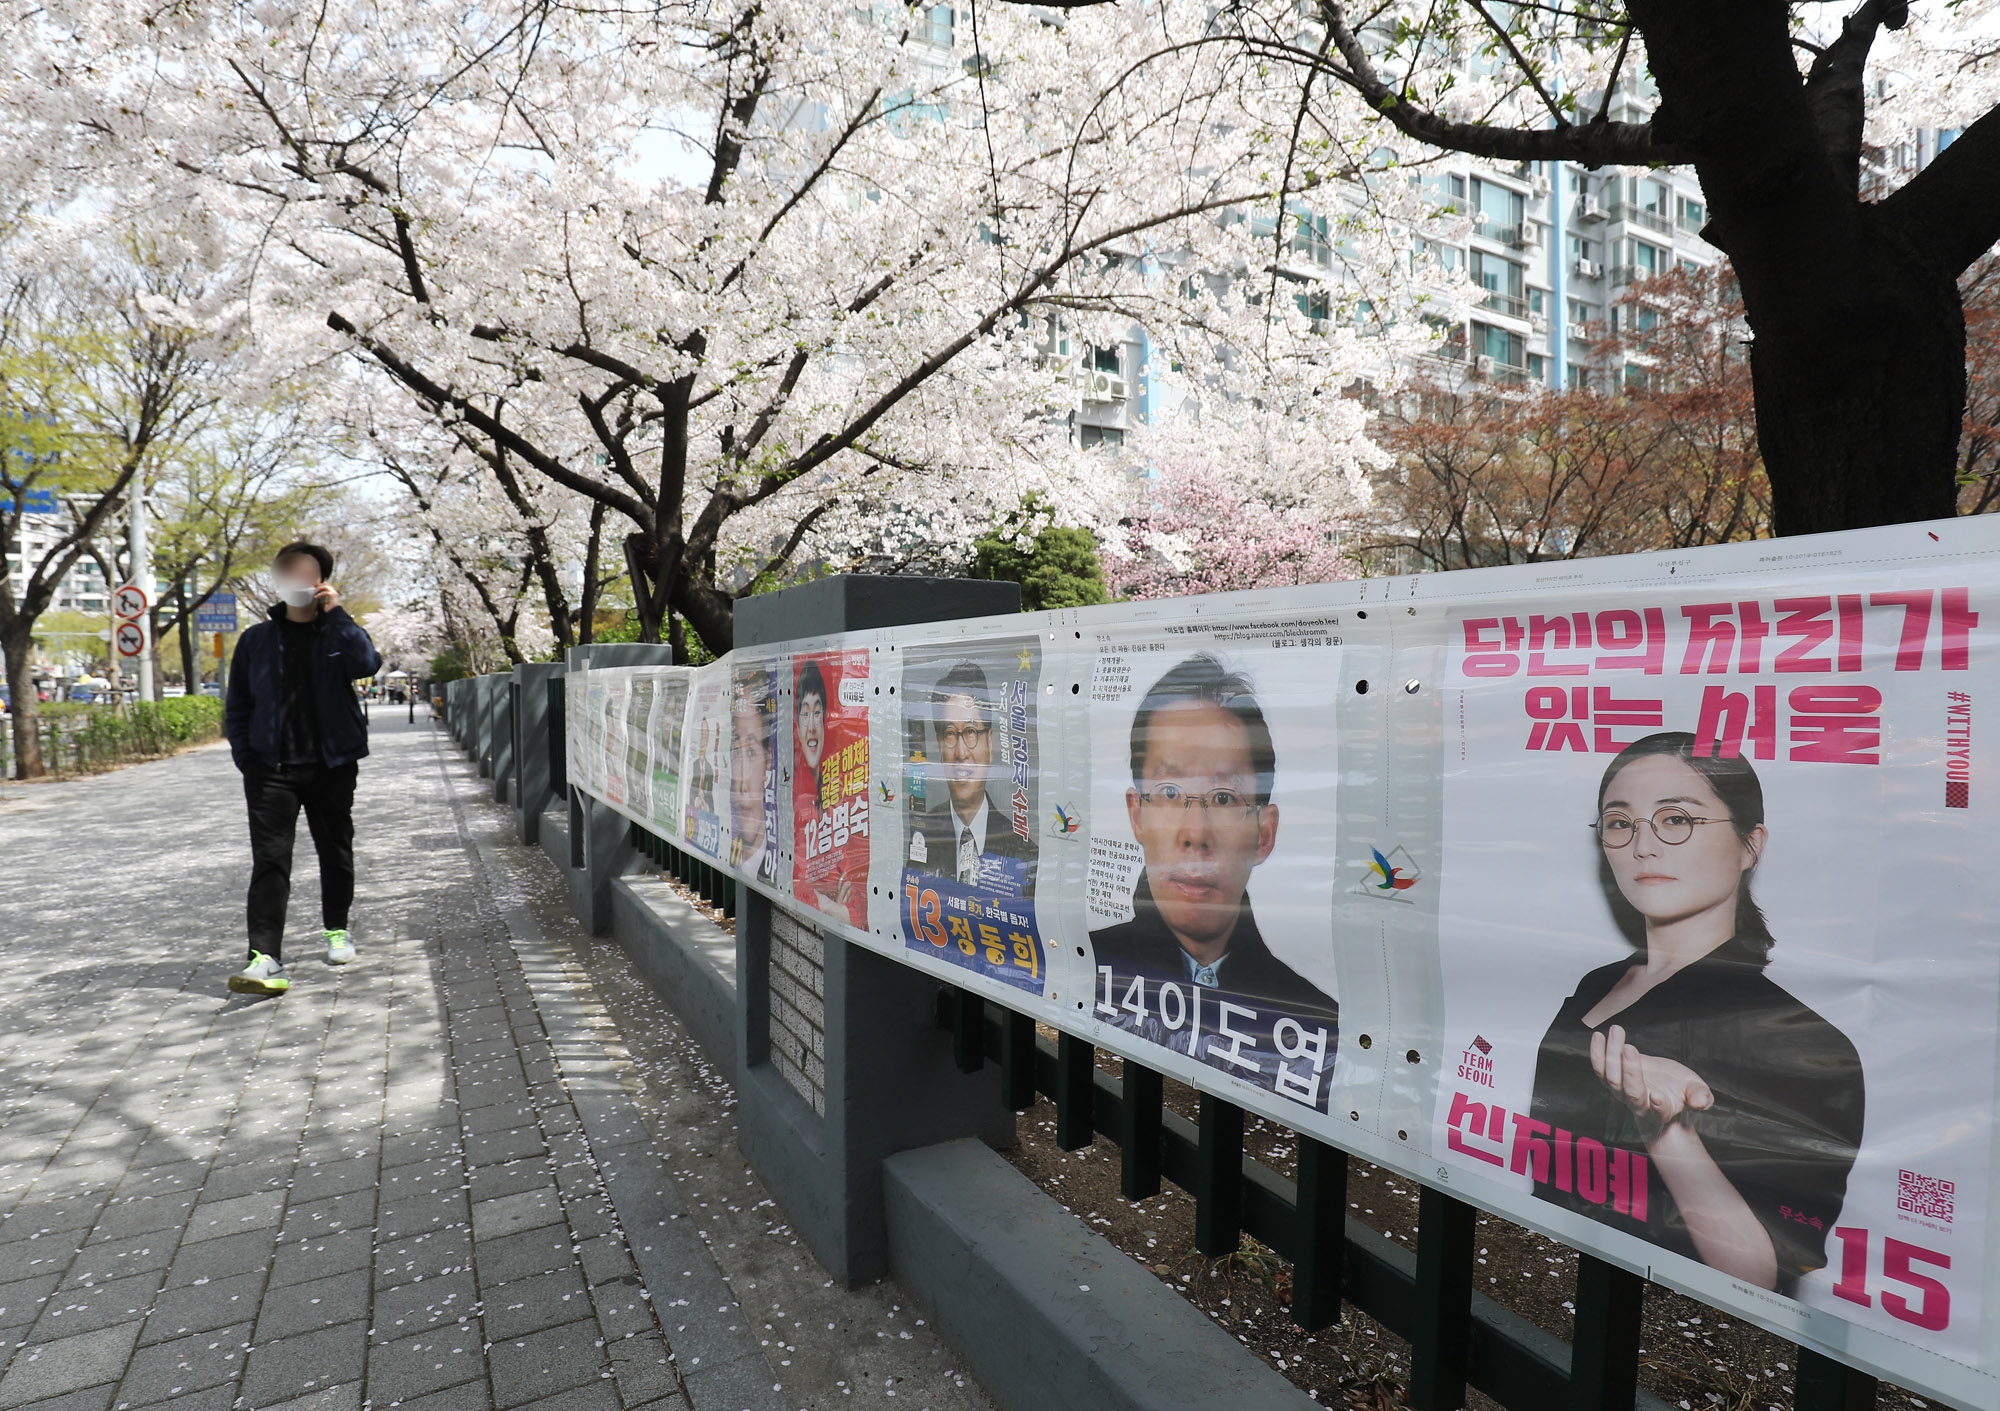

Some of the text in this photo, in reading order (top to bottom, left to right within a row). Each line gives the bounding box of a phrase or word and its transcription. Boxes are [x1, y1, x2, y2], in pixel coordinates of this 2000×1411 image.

[1461, 587, 1980, 678] 당신의 자리가
[1010, 680, 1028, 733] 서울
[1524, 684, 1883, 766] 있는 서울
[1946, 691, 1971, 780] #WITHYOU
[822, 735, 868, 784] 강남 해체!
[822, 764, 868, 810] 평등 서울!
[1011, 735, 1029, 789] 경제
[731, 834, 742, 867] 11
[804, 795, 869, 861] 12 송명숙
[905, 883, 1039, 979] 13 정동희
[1096, 965, 1328, 1108] 14 이도엽
[1462, 1050, 1493, 1072] TEAM
[1457, 1065, 1495, 1089] SEOUL
[1447, 1091, 1648, 1222] 신지예
[1778, 1205, 1824, 1231] 무소속
[1833, 1226, 1952, 1332] 15
